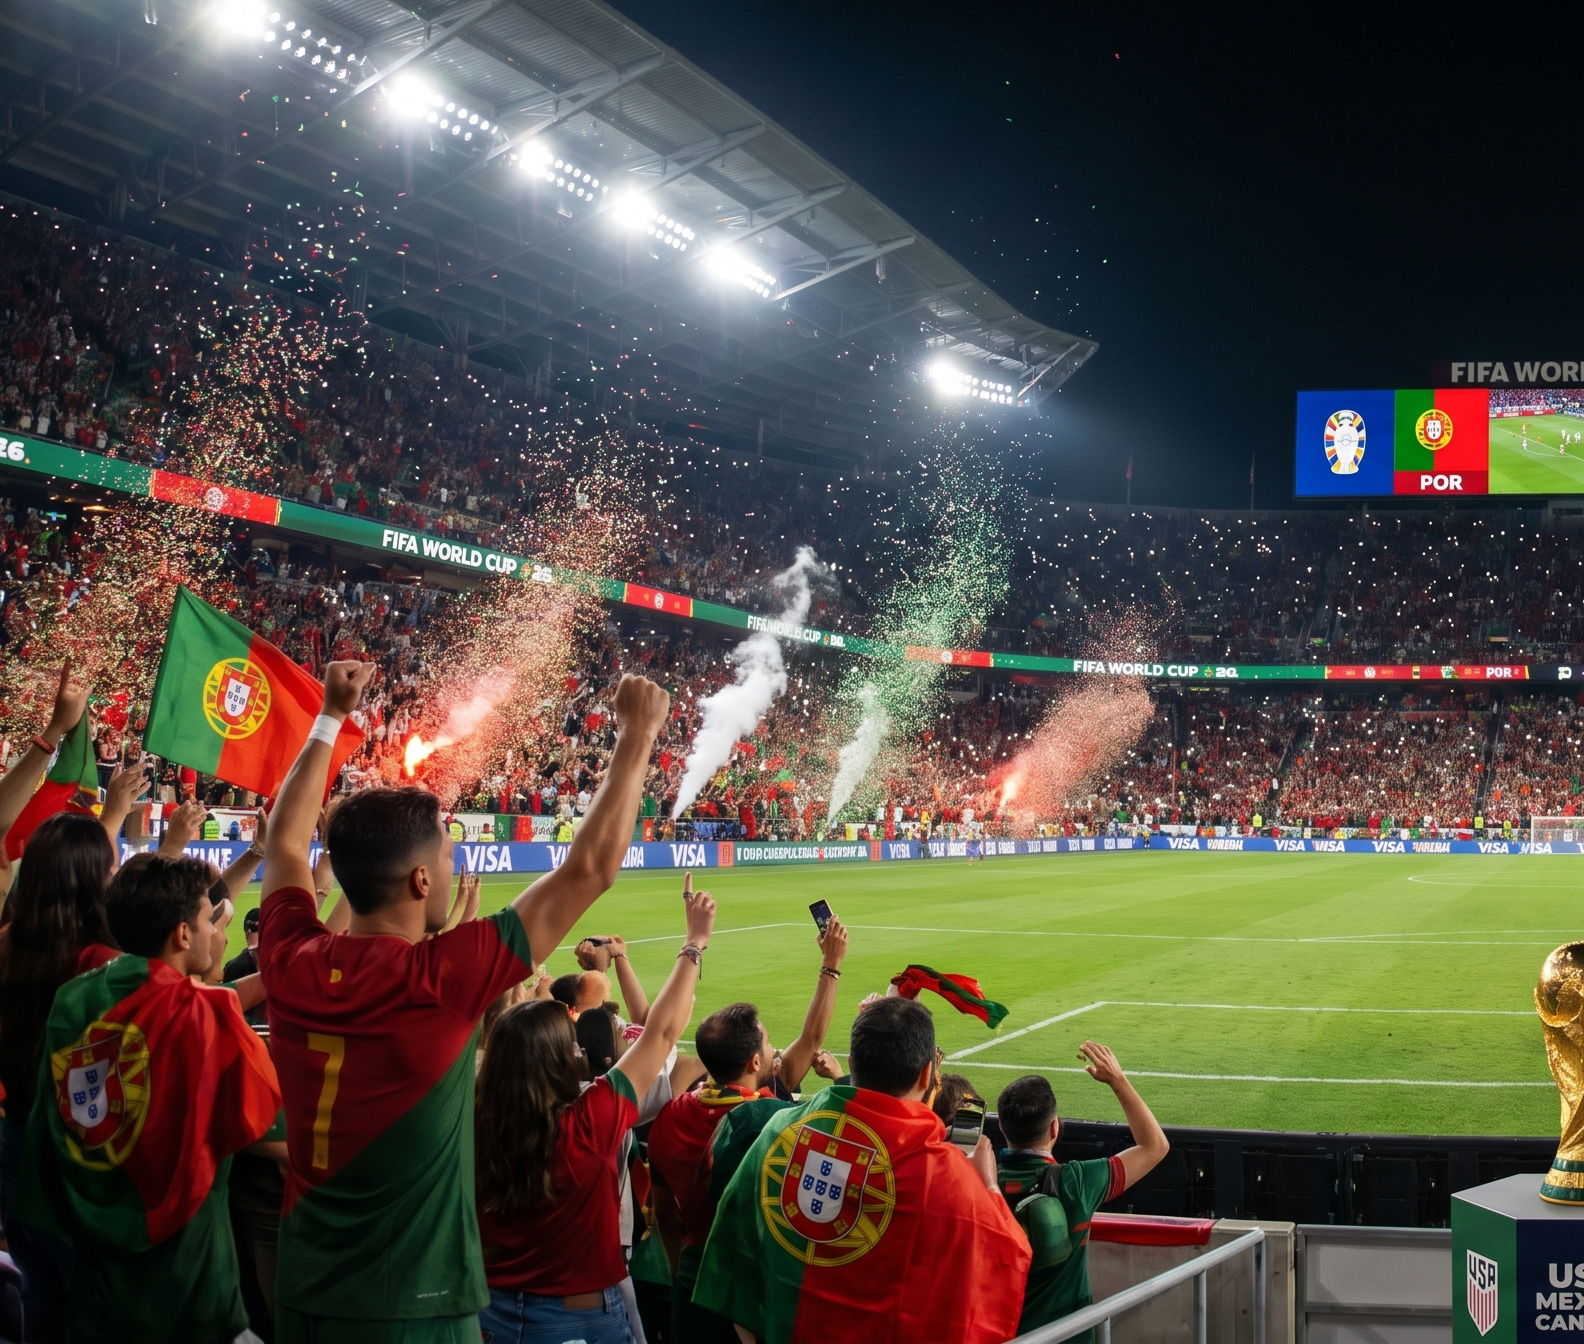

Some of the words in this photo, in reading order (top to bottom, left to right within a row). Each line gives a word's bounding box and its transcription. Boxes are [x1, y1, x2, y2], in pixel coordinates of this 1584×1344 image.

[1451, 362, 1509, 382] FIFA
[1420, 474, 1463, 490] POR
[382, 529, 418, 554] FIFA
[422, 538, 482, 567] WORLD
[485, 554, 517, 574] CUP
[803, 629, 821, 642] CUP
[1073, 660, 1106, 673] FIFA
[1108, 662, 1163, 676] WORLD
[1167, 665, 1198, 677] CUP
[1486, 667, 1512, 678] POR
[1167, 837, 1199, 849] VISA
[1274, 840, 1305, 851] VISA
[1372, 841, 1405, 852] VISA
[1478, 843, 1508, 853] VISA
[461, 845, 512, 872] VISA
[669, 843, 706, 867] VISA
[307, 1031, 345, 1170] 7
[1468, 1253, 1496, 1290] USA
